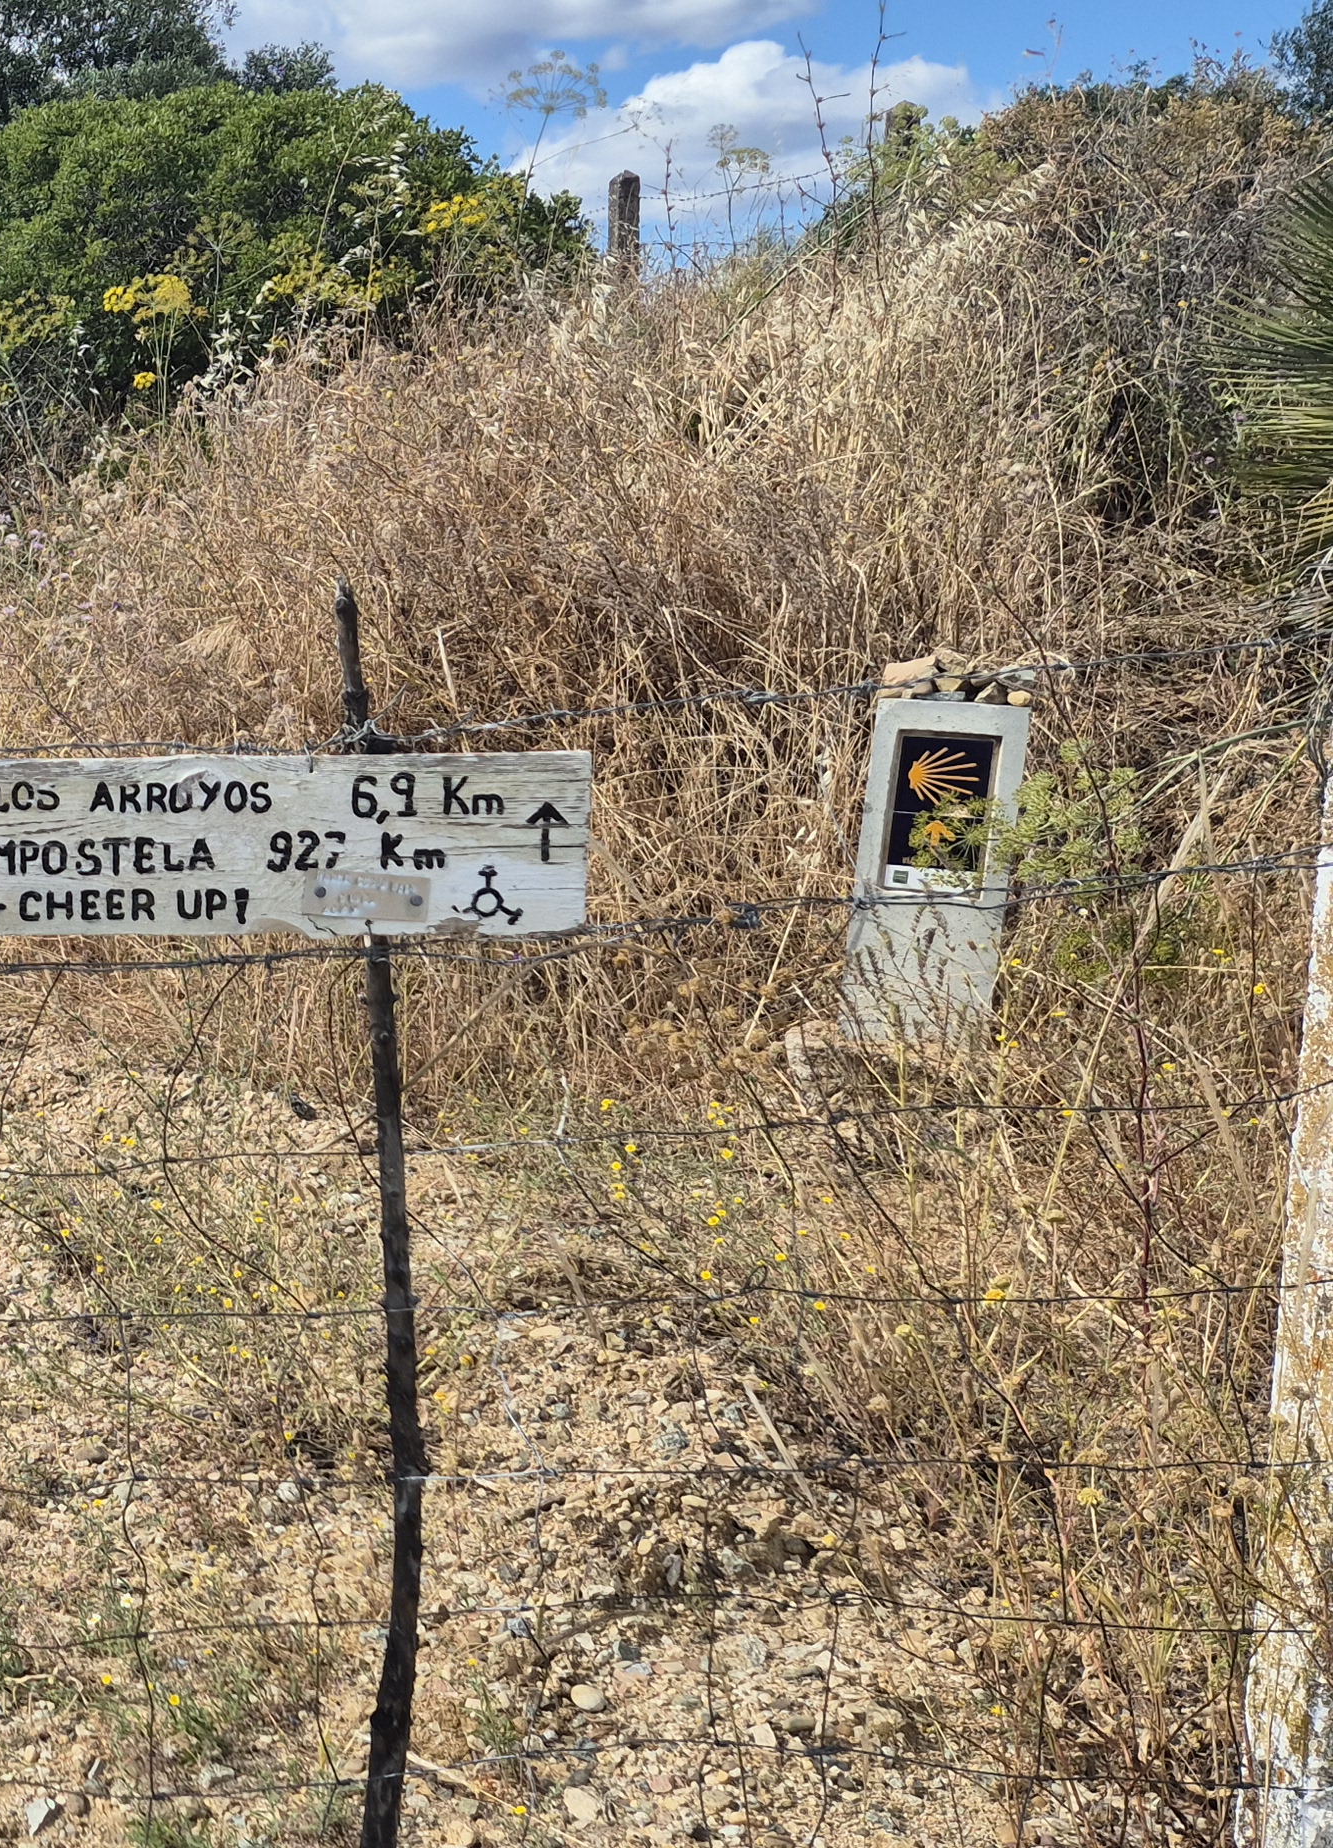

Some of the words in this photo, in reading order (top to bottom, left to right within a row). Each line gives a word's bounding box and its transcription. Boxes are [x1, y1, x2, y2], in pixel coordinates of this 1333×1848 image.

[89, 781, 273, 814] ARROYOS
[351, 771, 418, 825] 6,9
[442, 775, 506, 815] Km
[267, 830, 346, 873] 927
[380, 831, 447, 871] Km
[19, 888, 156, 922] CHEER
[176, 887, 250, 925] UP!
